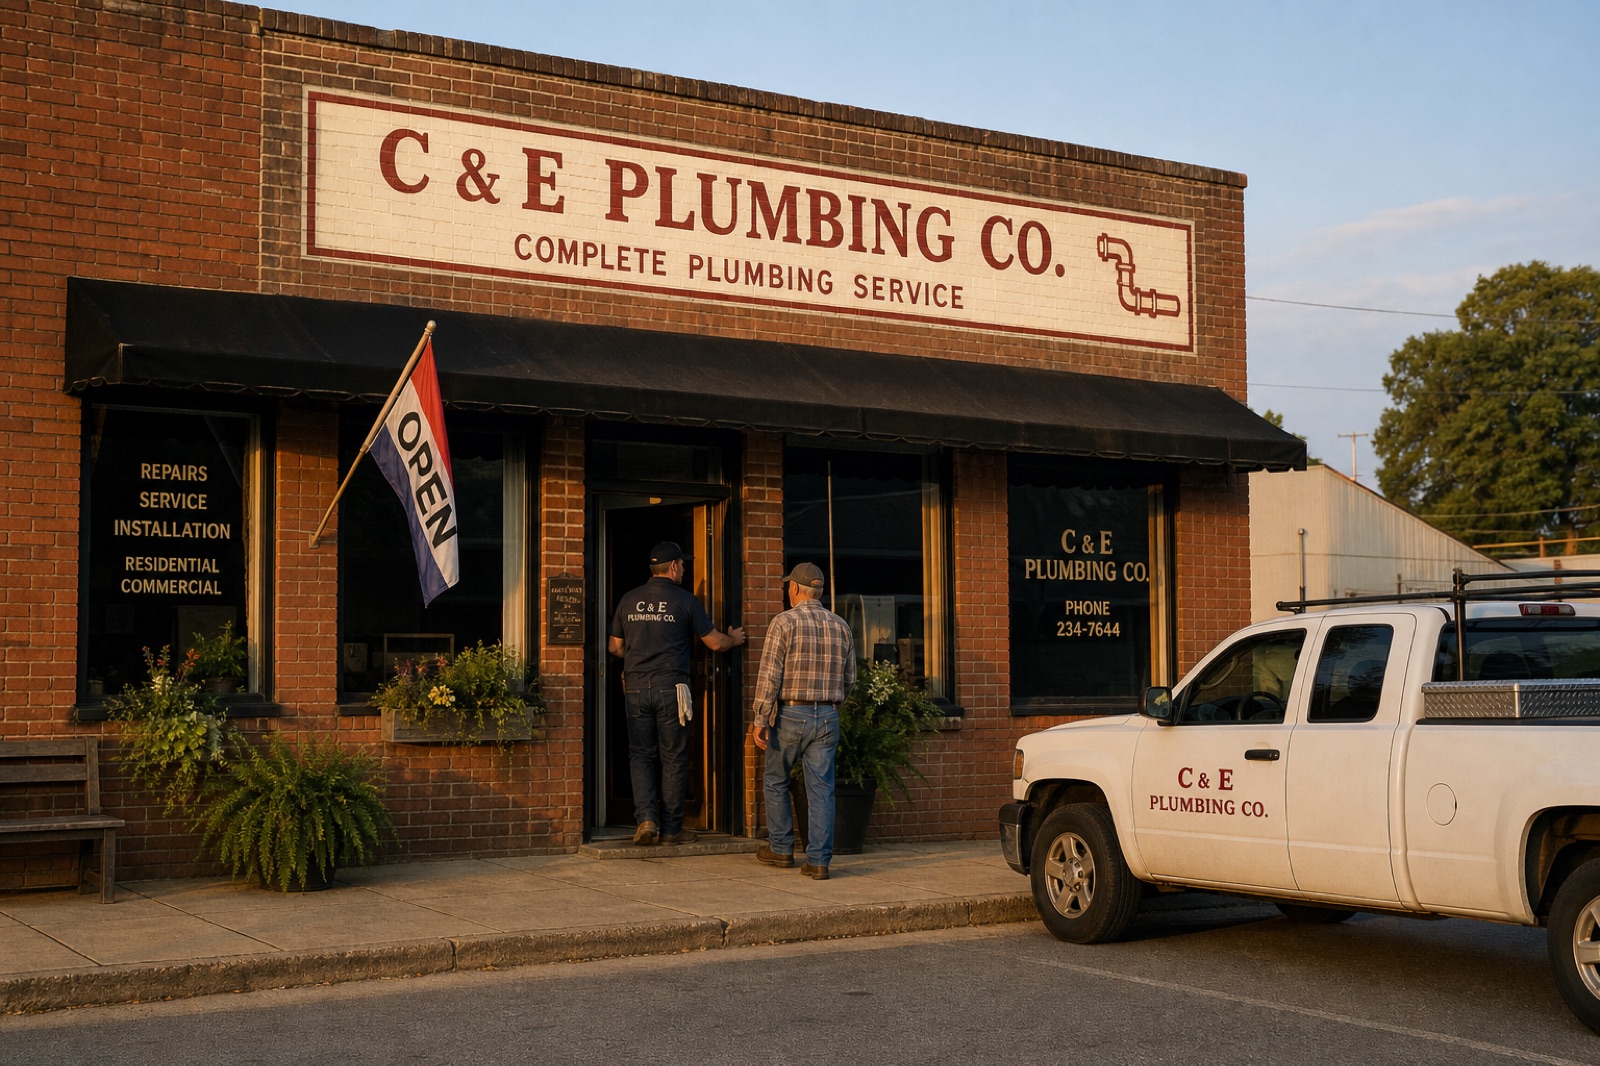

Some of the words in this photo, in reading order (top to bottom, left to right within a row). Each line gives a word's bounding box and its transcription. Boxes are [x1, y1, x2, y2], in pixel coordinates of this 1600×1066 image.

[380, 128, 430, 194] C
[456, 148, 500, 205] &
[522, 147, 565, 214] E
[605, 158, 955, 263] PLUMBING
[981, 215, 1065, 277] CO.
[514, 233, 667, 276] COMPLETE
[689, 254, 833, 295] PLUMBING
[853, 274, 964, 309] SERVICE
[140, 463, 208, 482] REPAIRS
[397, 411, 458, 550] OPEN
[139, 491, 208, 510] SERVICE
[114, 519, 231, 540] INSTALLATION
[1061, 528, 1076, 554] C
[1081, 534, 1095, 554] &
[1099, 530, 1114, 555] E
[125, 556, 220, 573] RESIDENTIAL
[1024, 558, 1117, 582] PLUMBING
[1122, 561, 1150, 582] CO.
[120, 578, 222, 595] COMMERCIAL
[636, 601, 645, 612] C
[647, 603, 655, 612] &
[657, 601, 667, 613] E
[1065, 600, 1110, 615] PHONE
[627, 613, 661, 622] PLUMBING
[663, 614, 676, 622] CO.
[1056, 621, 1121, 637] 234-7644
[1178, 767, 1193, 789] C
[1198, 772, 1210, 789] &
[1218, 768, 1234, 791] E
[1149, 795, 1236, 815] PLUMBING
[1241, 801, 1269, 818] CO.
